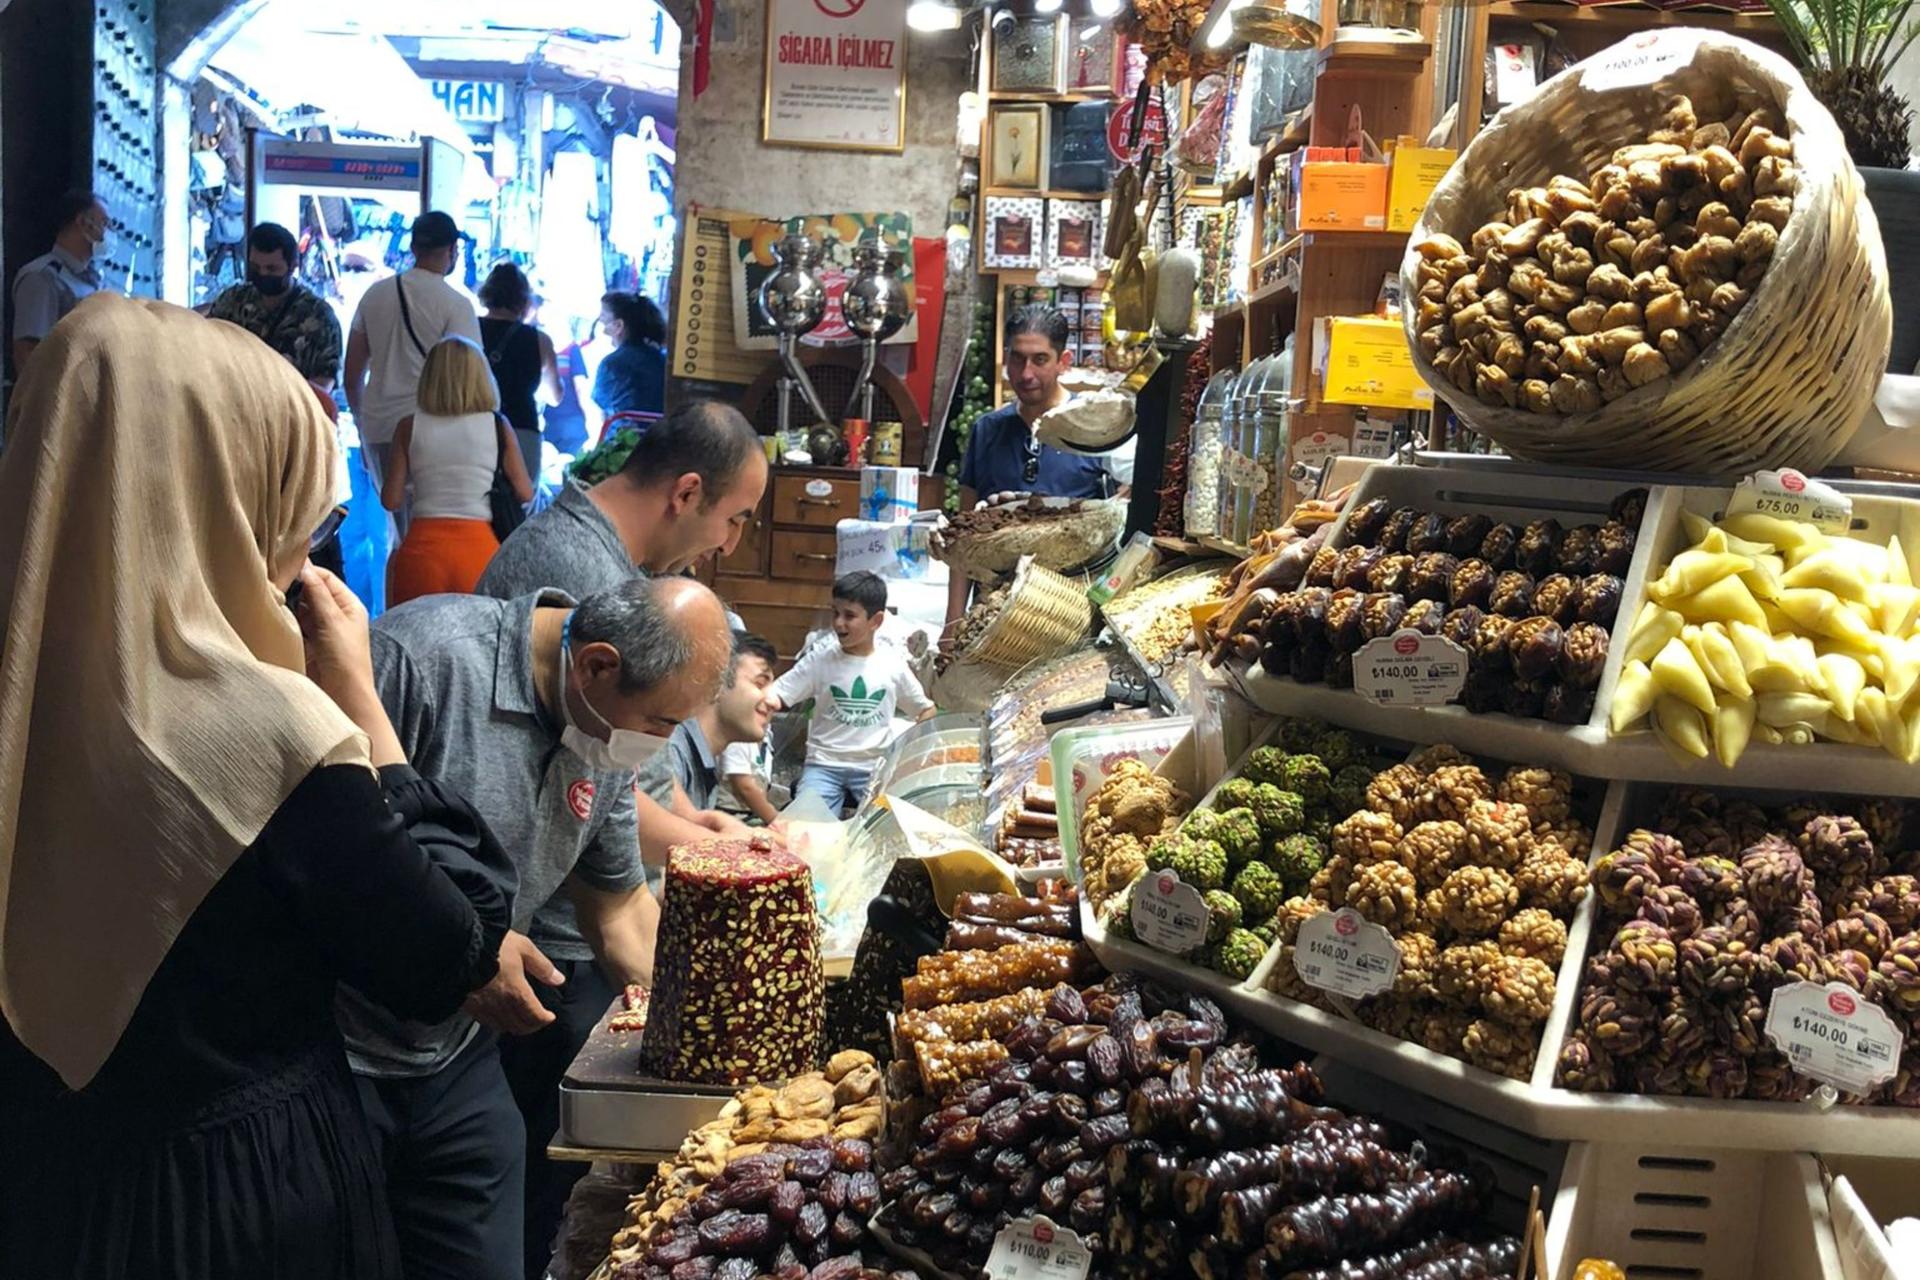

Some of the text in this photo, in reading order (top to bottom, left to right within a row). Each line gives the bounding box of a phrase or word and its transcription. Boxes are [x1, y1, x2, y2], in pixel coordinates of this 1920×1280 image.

[778, 31, 895, 71] SİGARA İÇİLMEZ
[1372, 666, 1418, 679] ₺140,00
[1793, 1015, 1848, 1045] ₺140,00
